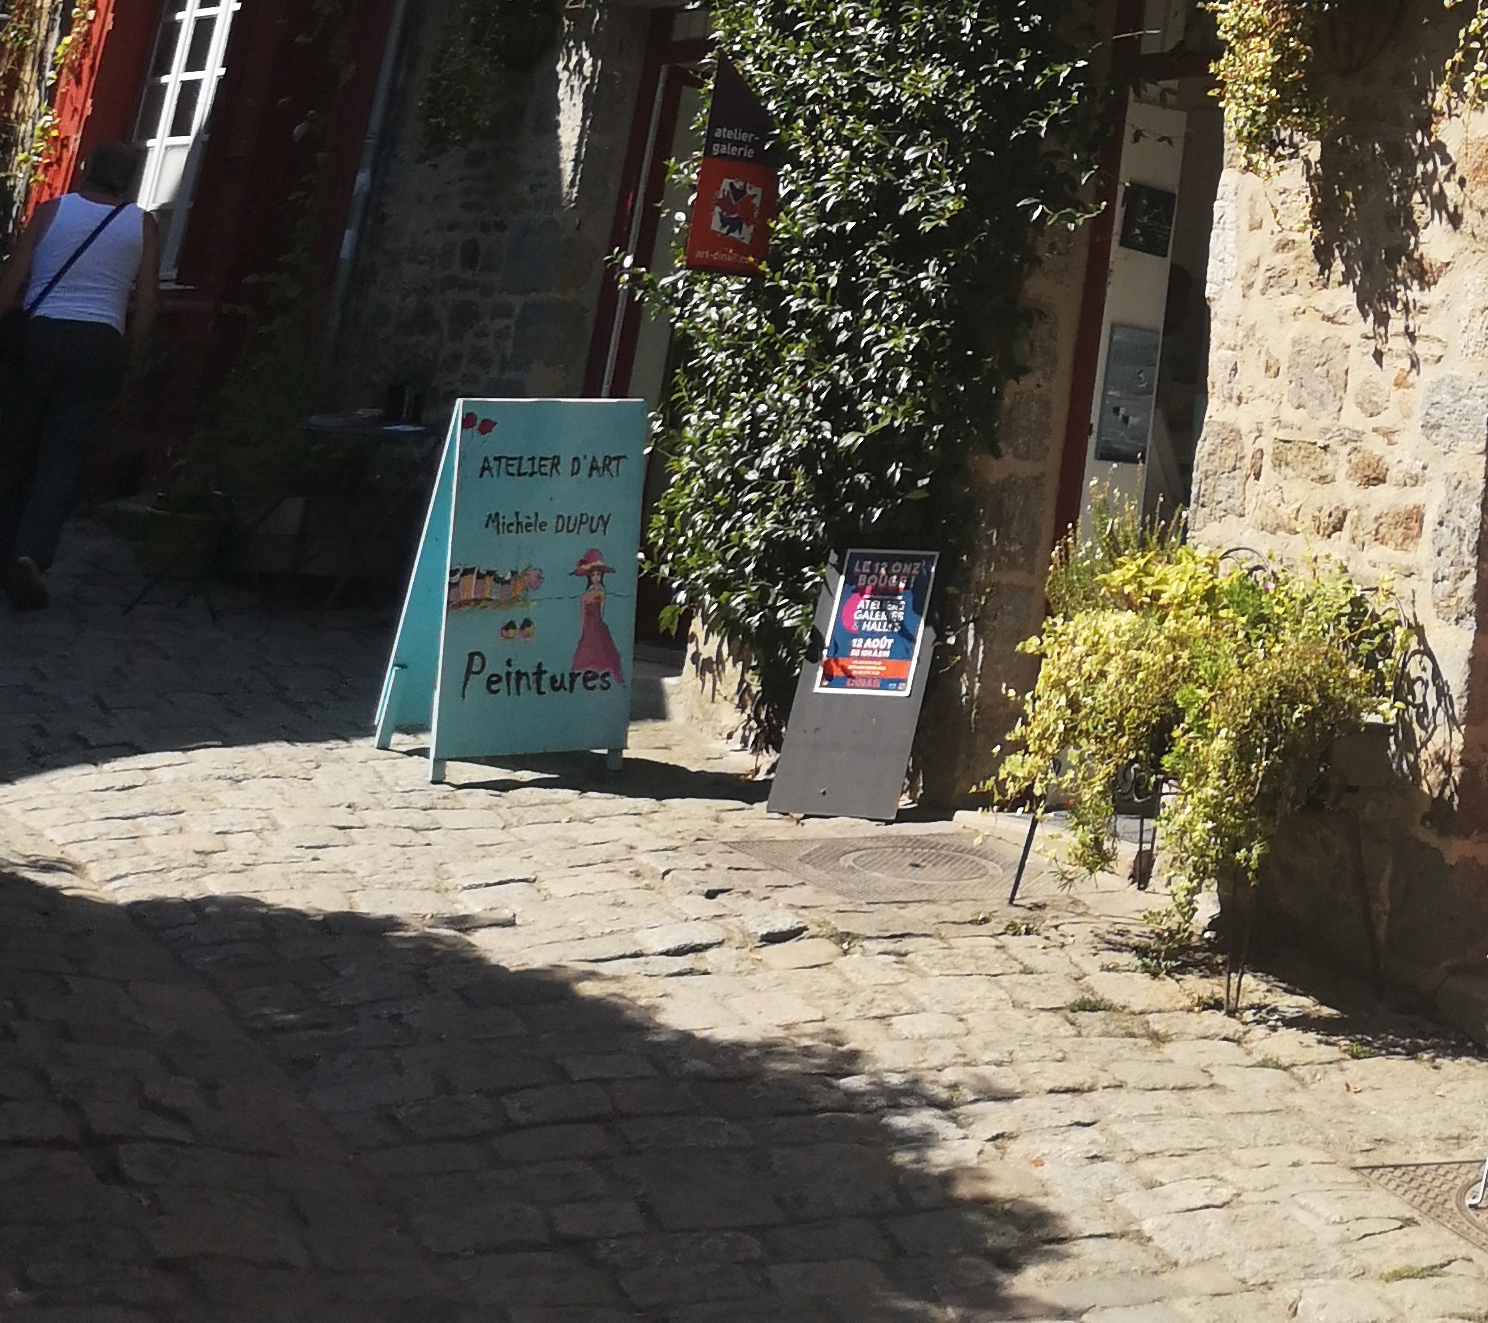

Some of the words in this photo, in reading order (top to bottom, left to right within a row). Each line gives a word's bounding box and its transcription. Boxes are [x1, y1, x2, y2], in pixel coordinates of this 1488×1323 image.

[714, 126, 760, 144] atelier-
[711, 141, 756, 159] galerie
[478, 454, 562, 479] ATELIER
[570, 454, 628, 478] D'ART
[484, 511, 548, 535] Michèle
[554, 512, 613, 536] DUPUY
[854, 560, 872, 574] LE
[851, 637, 863, 648] 12
[863, 635, 895, 650] AOÛT
[461, 650, 613, 700] Peintures
